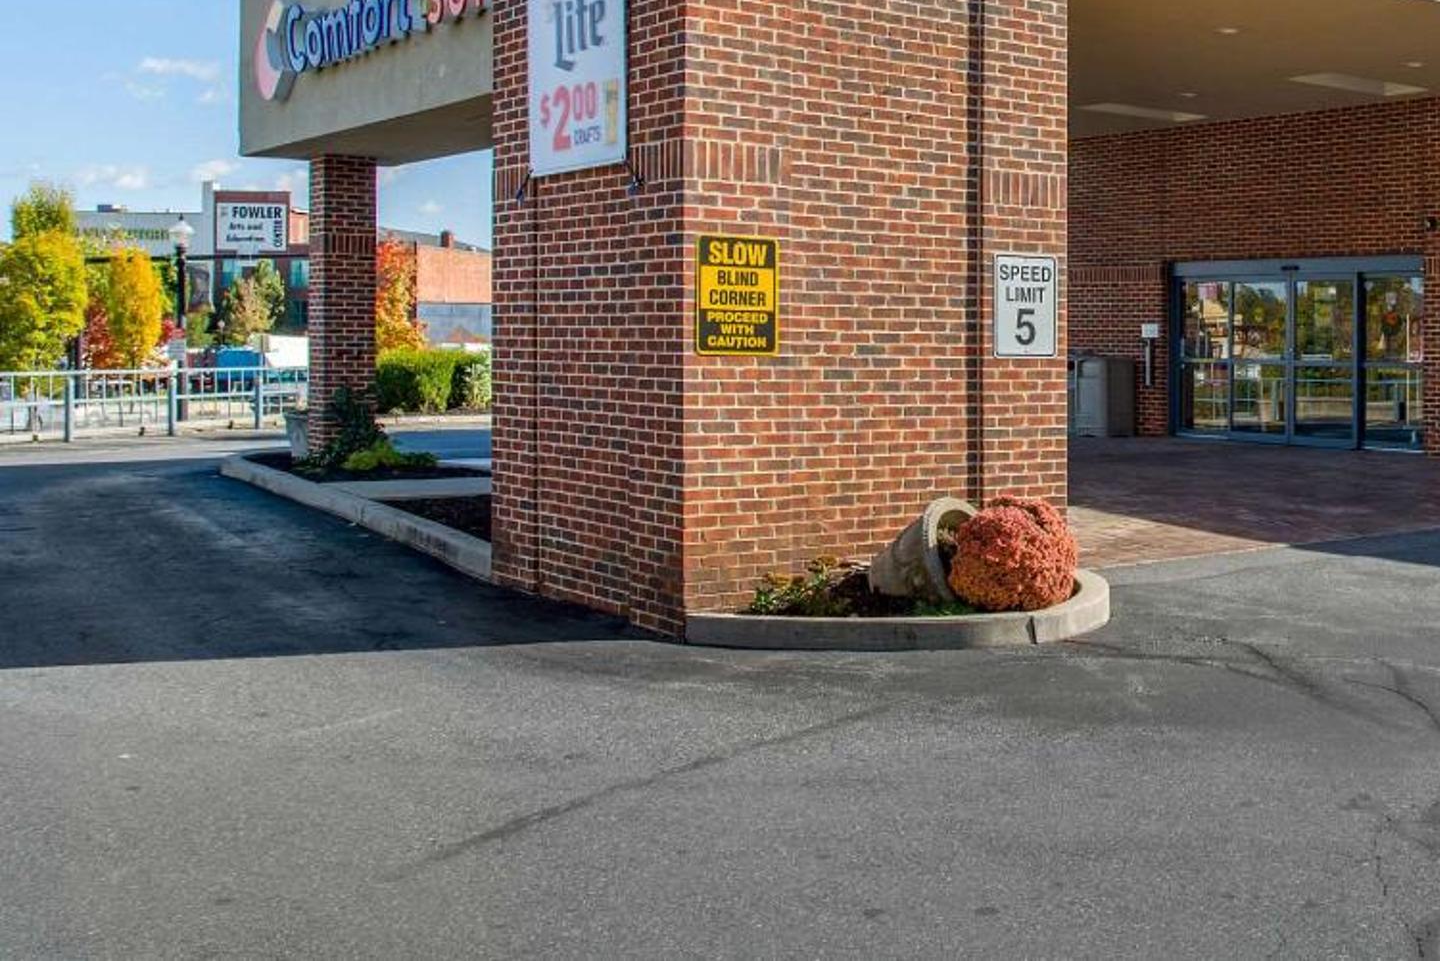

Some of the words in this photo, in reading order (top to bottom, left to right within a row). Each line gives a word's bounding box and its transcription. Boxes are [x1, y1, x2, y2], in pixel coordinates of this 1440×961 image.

[231, 205, 283, 219] FOWLER
[708, 241, 768, 267] SLOW
[717, 269, 759, 287] BLIND
[999, 263, 1053, 283] SPEED
[709, 288, 767, 307] CORNER
[1005, 286, 1046, 304] LIMIT
[707, 311, 768, 325] PROCEED
[1015, 308, 1036, 346] 5
[720, 323, 755, 335] WITH
[707, 336, 767, 349] CAUTION
